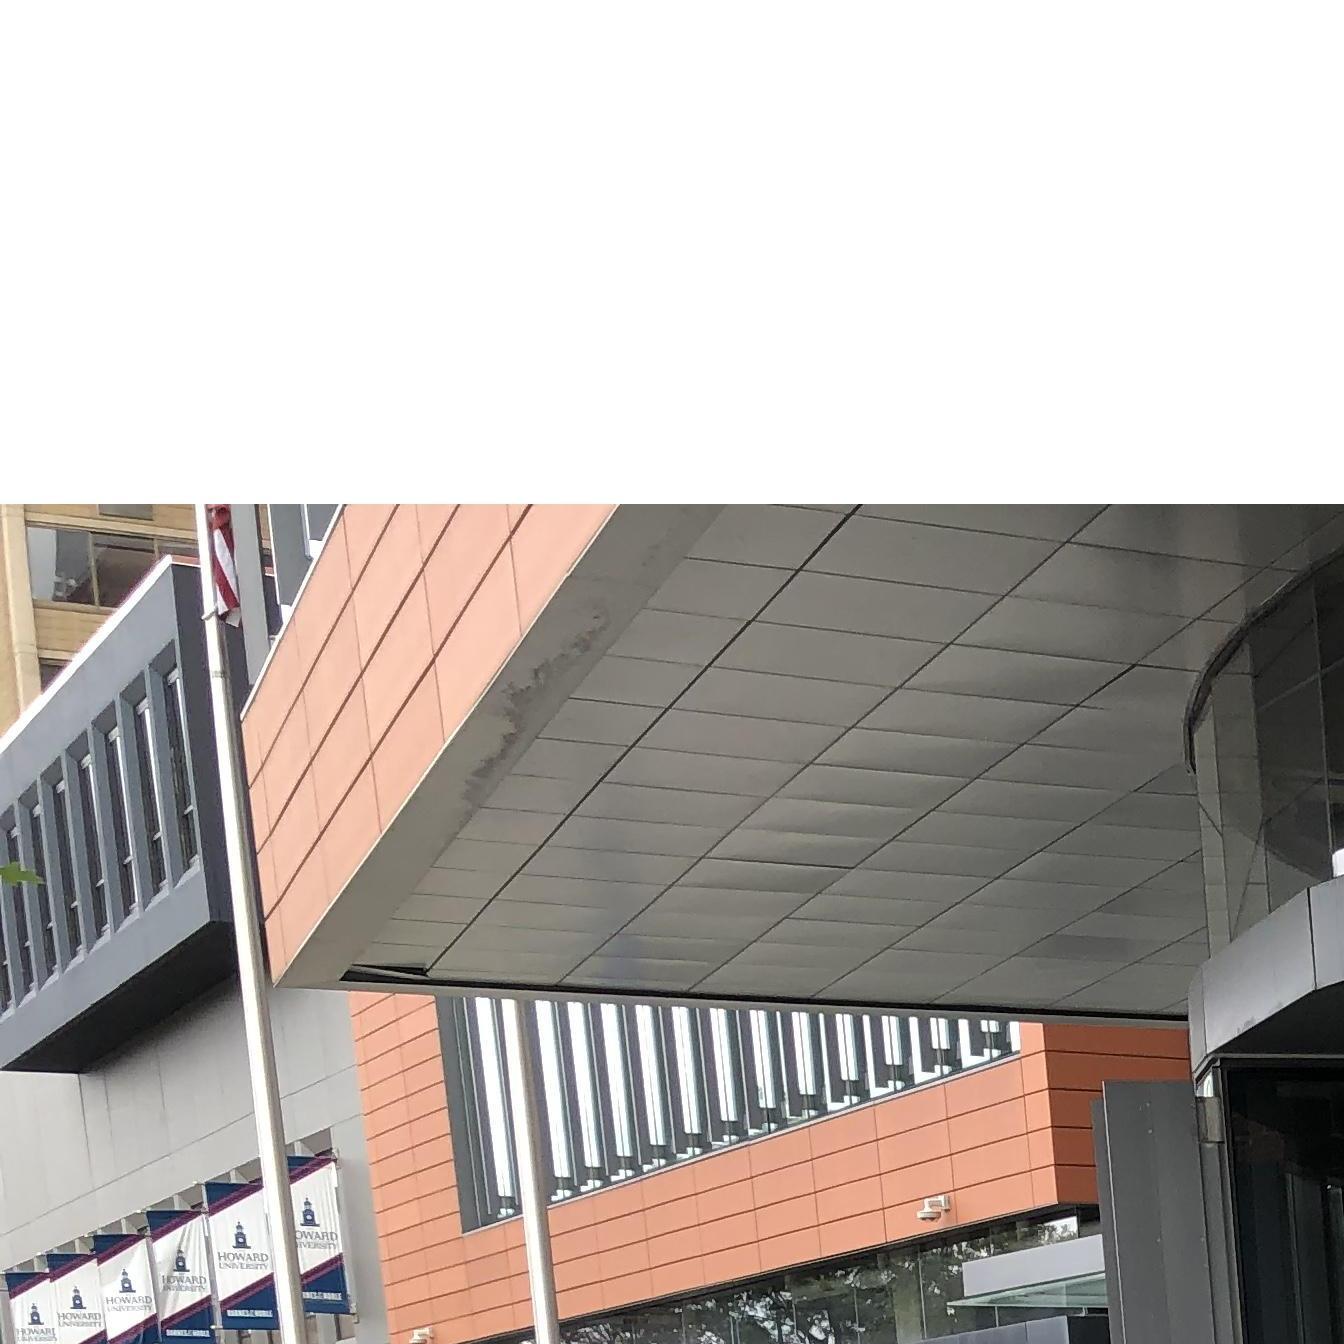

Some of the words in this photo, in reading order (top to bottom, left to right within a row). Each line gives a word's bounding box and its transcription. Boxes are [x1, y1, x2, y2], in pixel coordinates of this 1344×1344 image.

[295, 1230, 338, 1241] OWARD
[296, 1241, 337, 1250] IVERSITY
[217, 1251, 269, 1262] HOWARD
[161, 1274, 207, 1285] HOWARD
[105, 1295, 153, 1305] HOWARD
[56, 1312, 102, 1321] HOWARD
